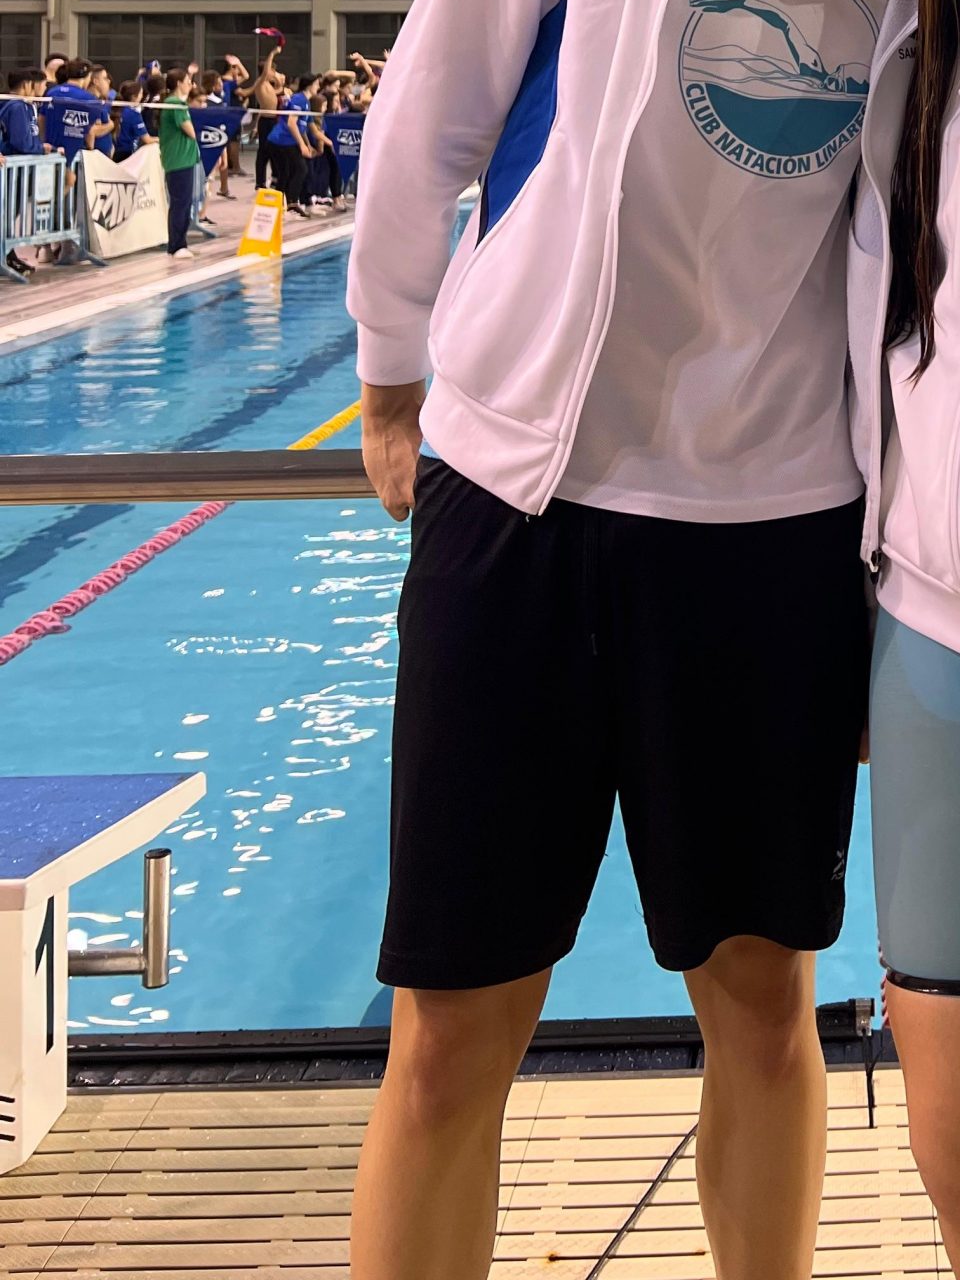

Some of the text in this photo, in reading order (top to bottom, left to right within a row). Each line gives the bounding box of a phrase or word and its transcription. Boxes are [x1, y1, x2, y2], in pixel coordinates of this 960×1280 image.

[62, 109, 89, 127] FAN
[685, 83, 721, 135] CLUB
[714, 131, 811, 175] NATACIÓN
[35, 895, 54, 1054] 1
